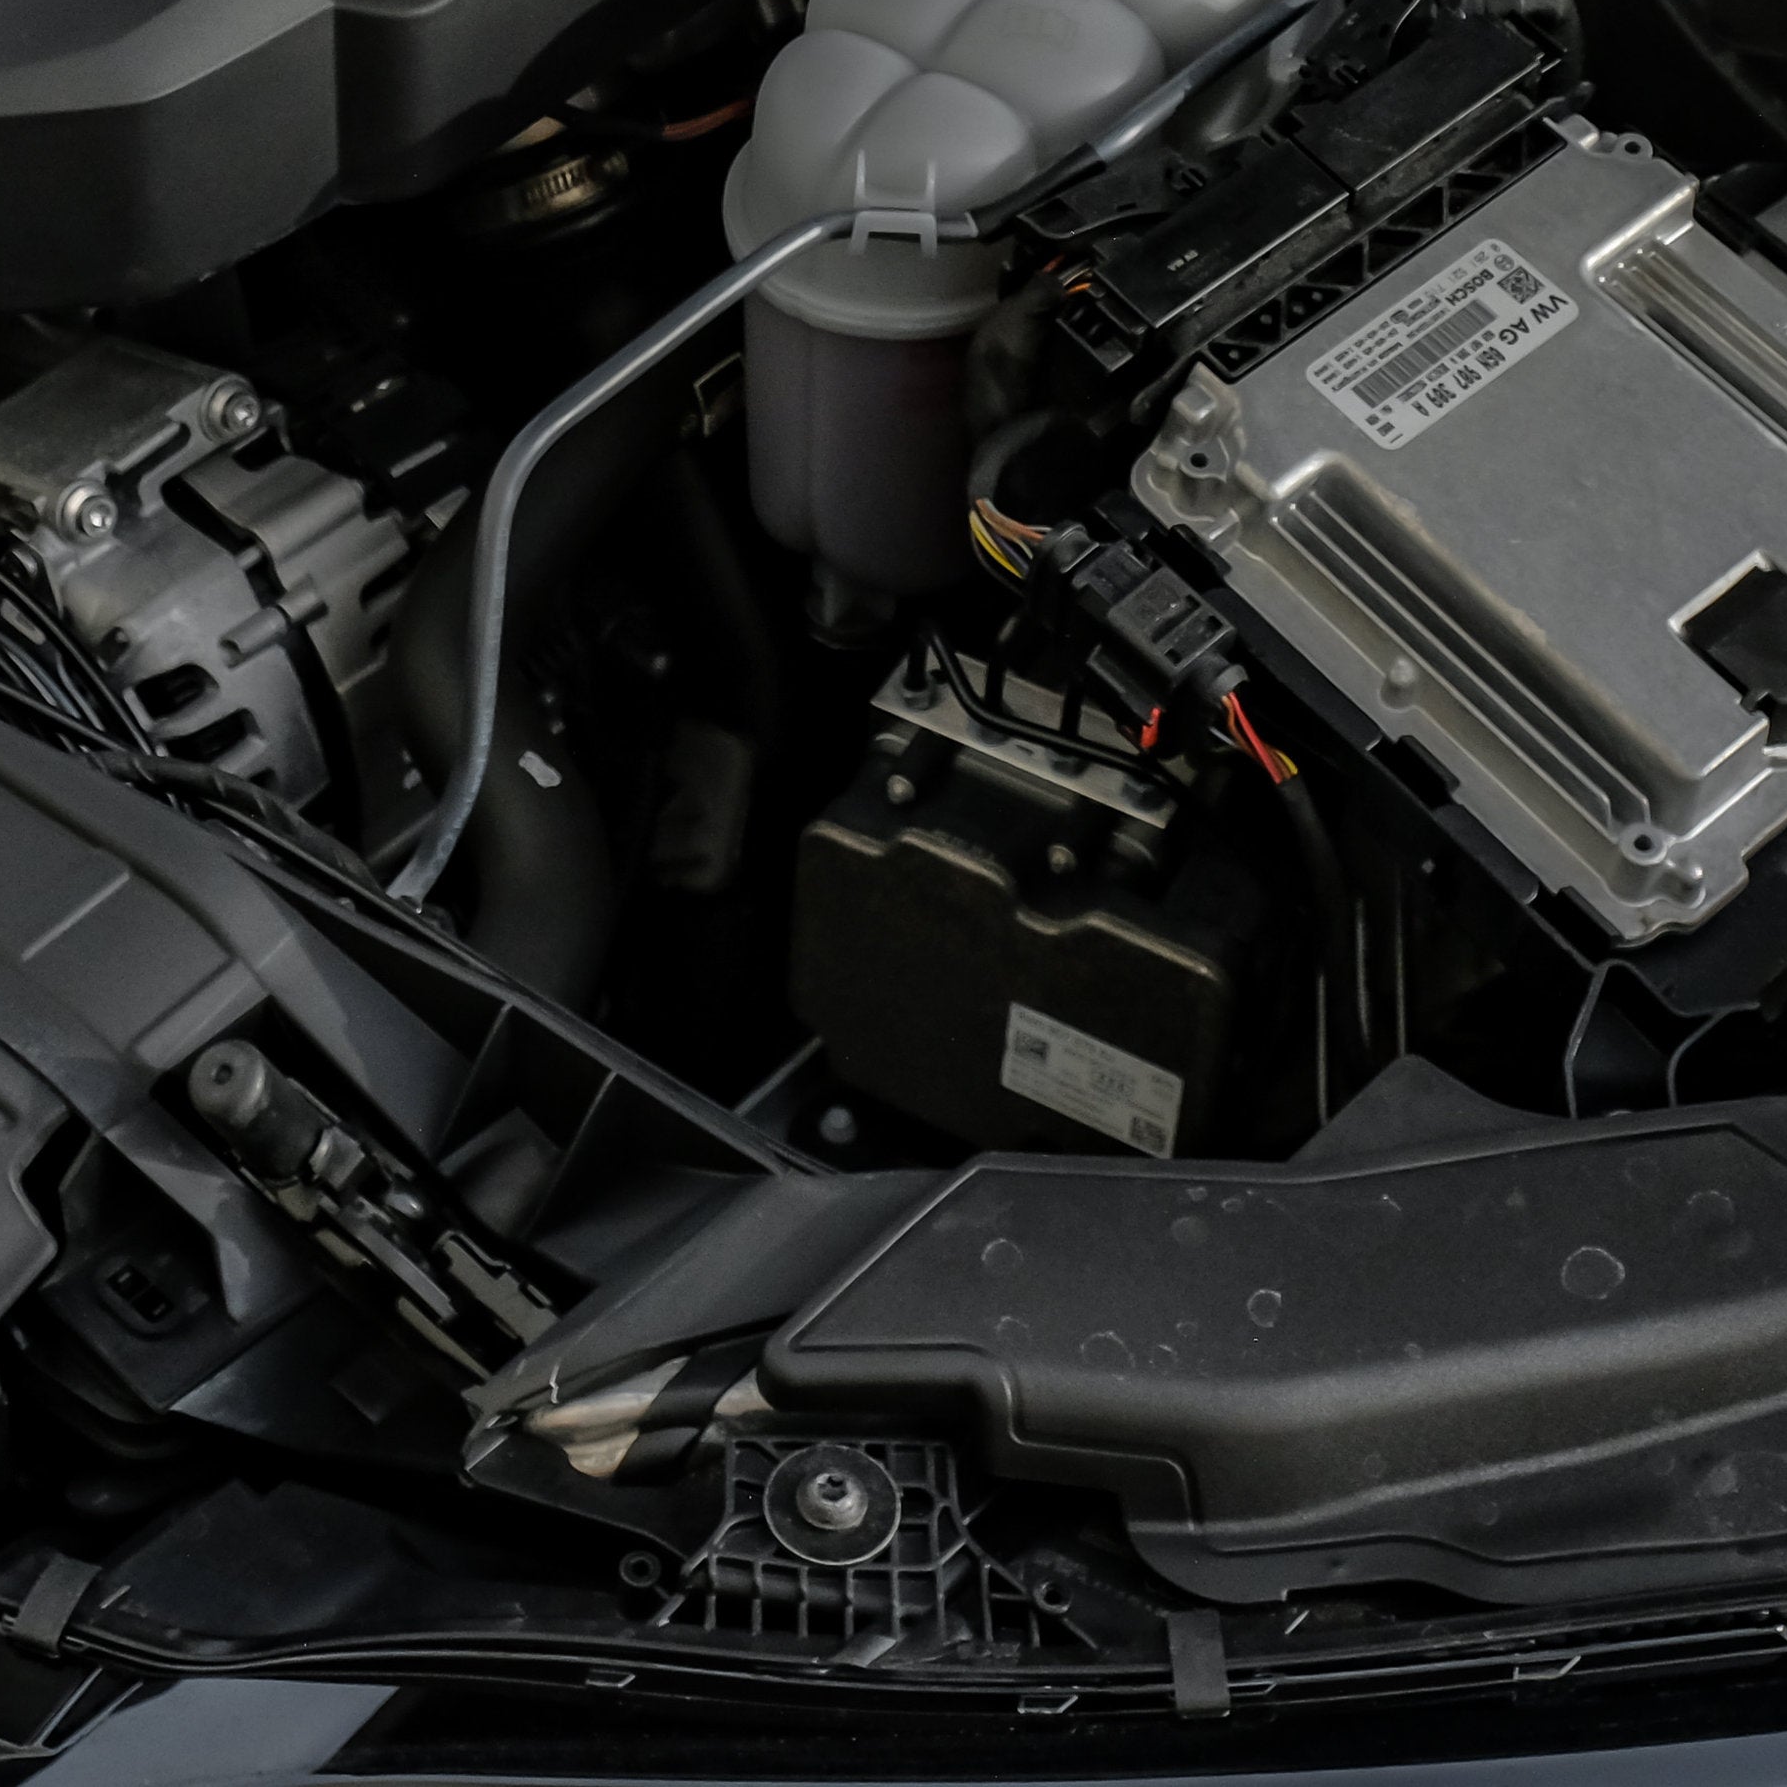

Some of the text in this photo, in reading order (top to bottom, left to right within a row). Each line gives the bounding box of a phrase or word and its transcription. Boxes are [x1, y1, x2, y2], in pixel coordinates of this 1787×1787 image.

[1445, 269, 1496, 307] BOSCH
[1493, 294, 1569, 346] VW AG
